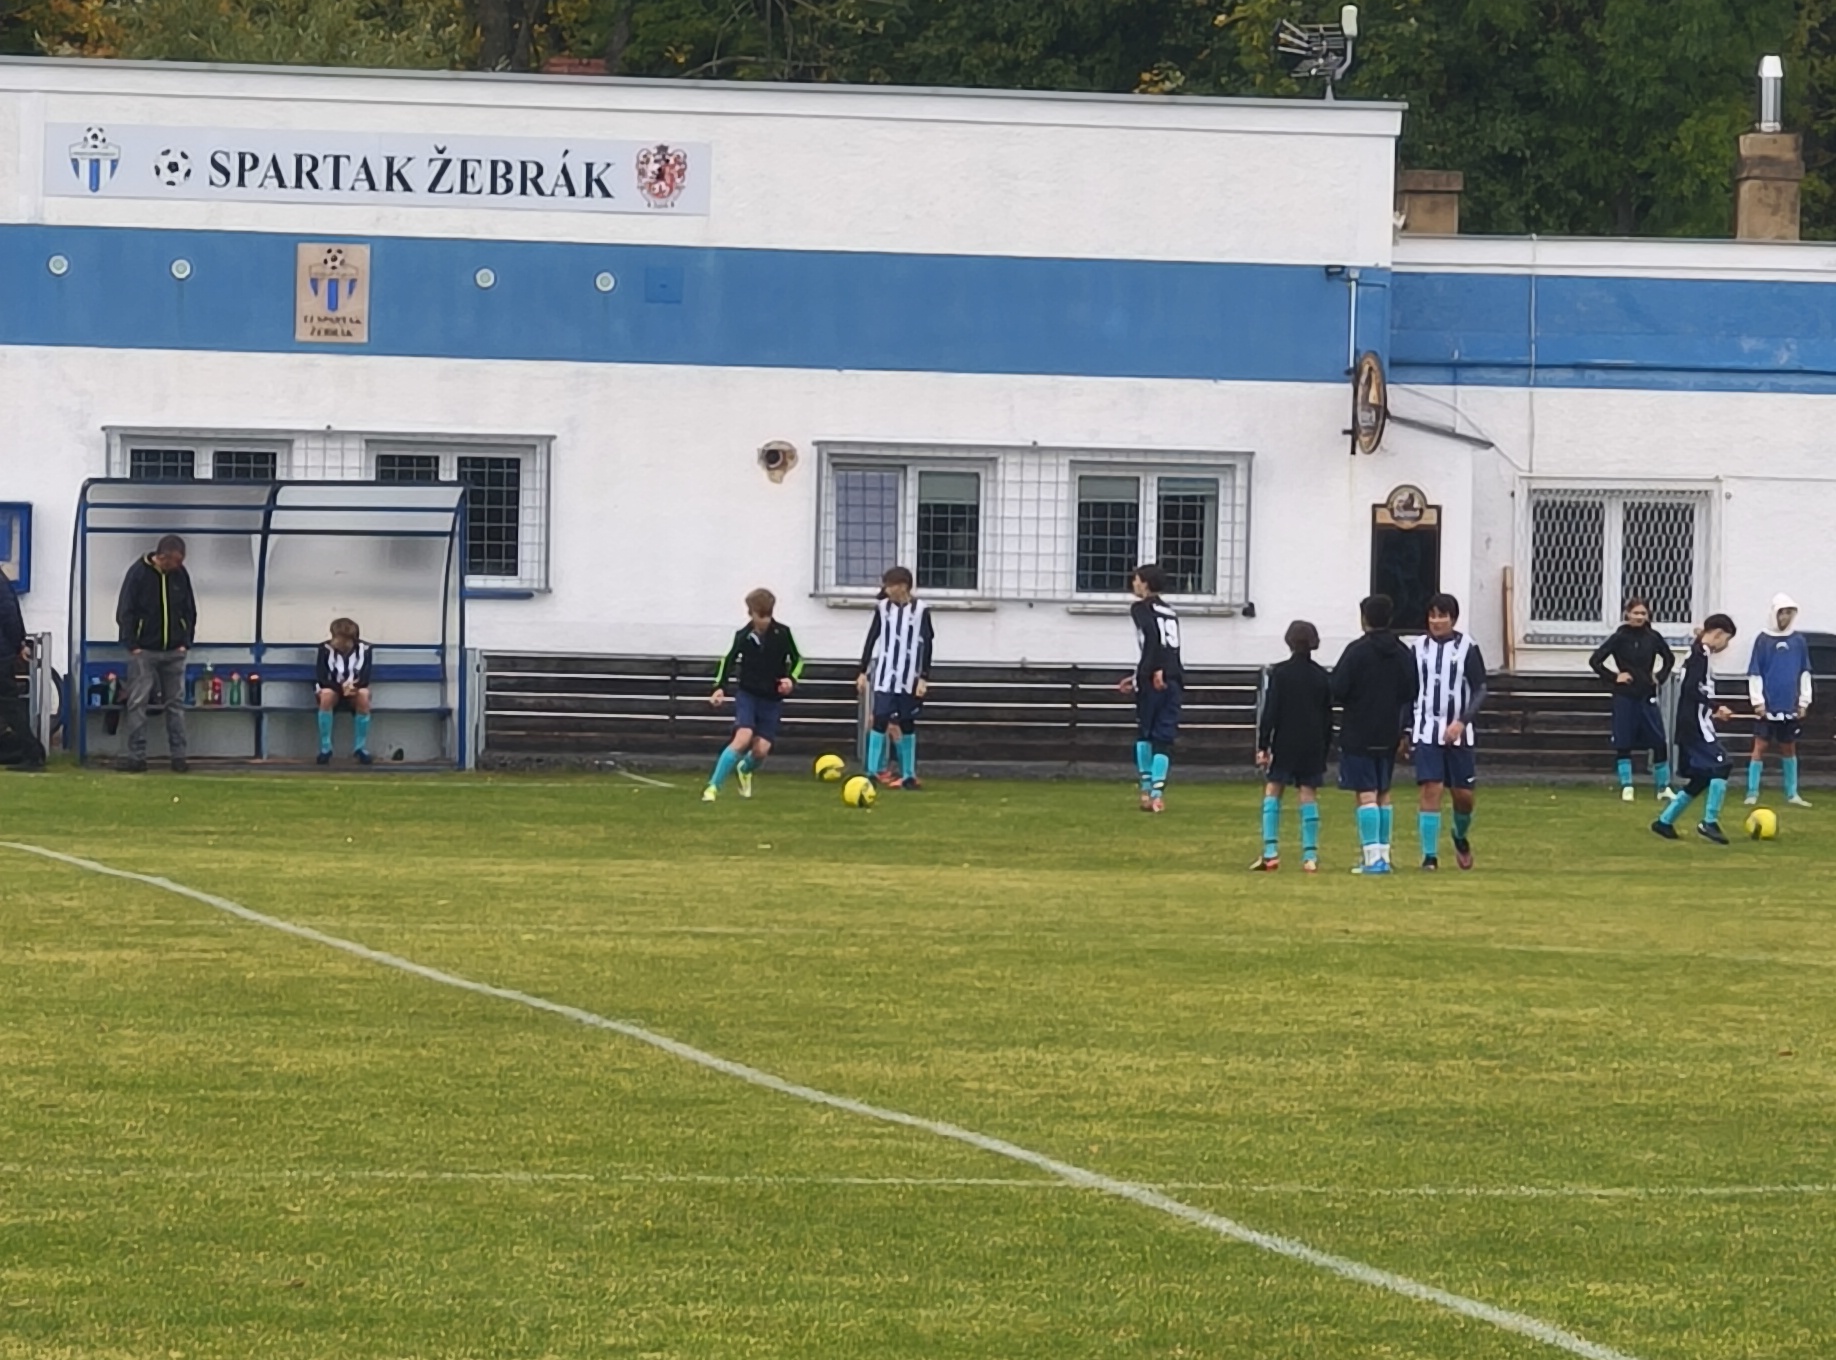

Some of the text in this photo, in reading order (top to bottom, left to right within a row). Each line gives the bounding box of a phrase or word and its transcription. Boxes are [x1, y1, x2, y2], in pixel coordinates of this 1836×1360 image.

[208, 145, 615, 199] SPARTAK ŽEBRÁK
[1156, 616, 1179, 649] 19
